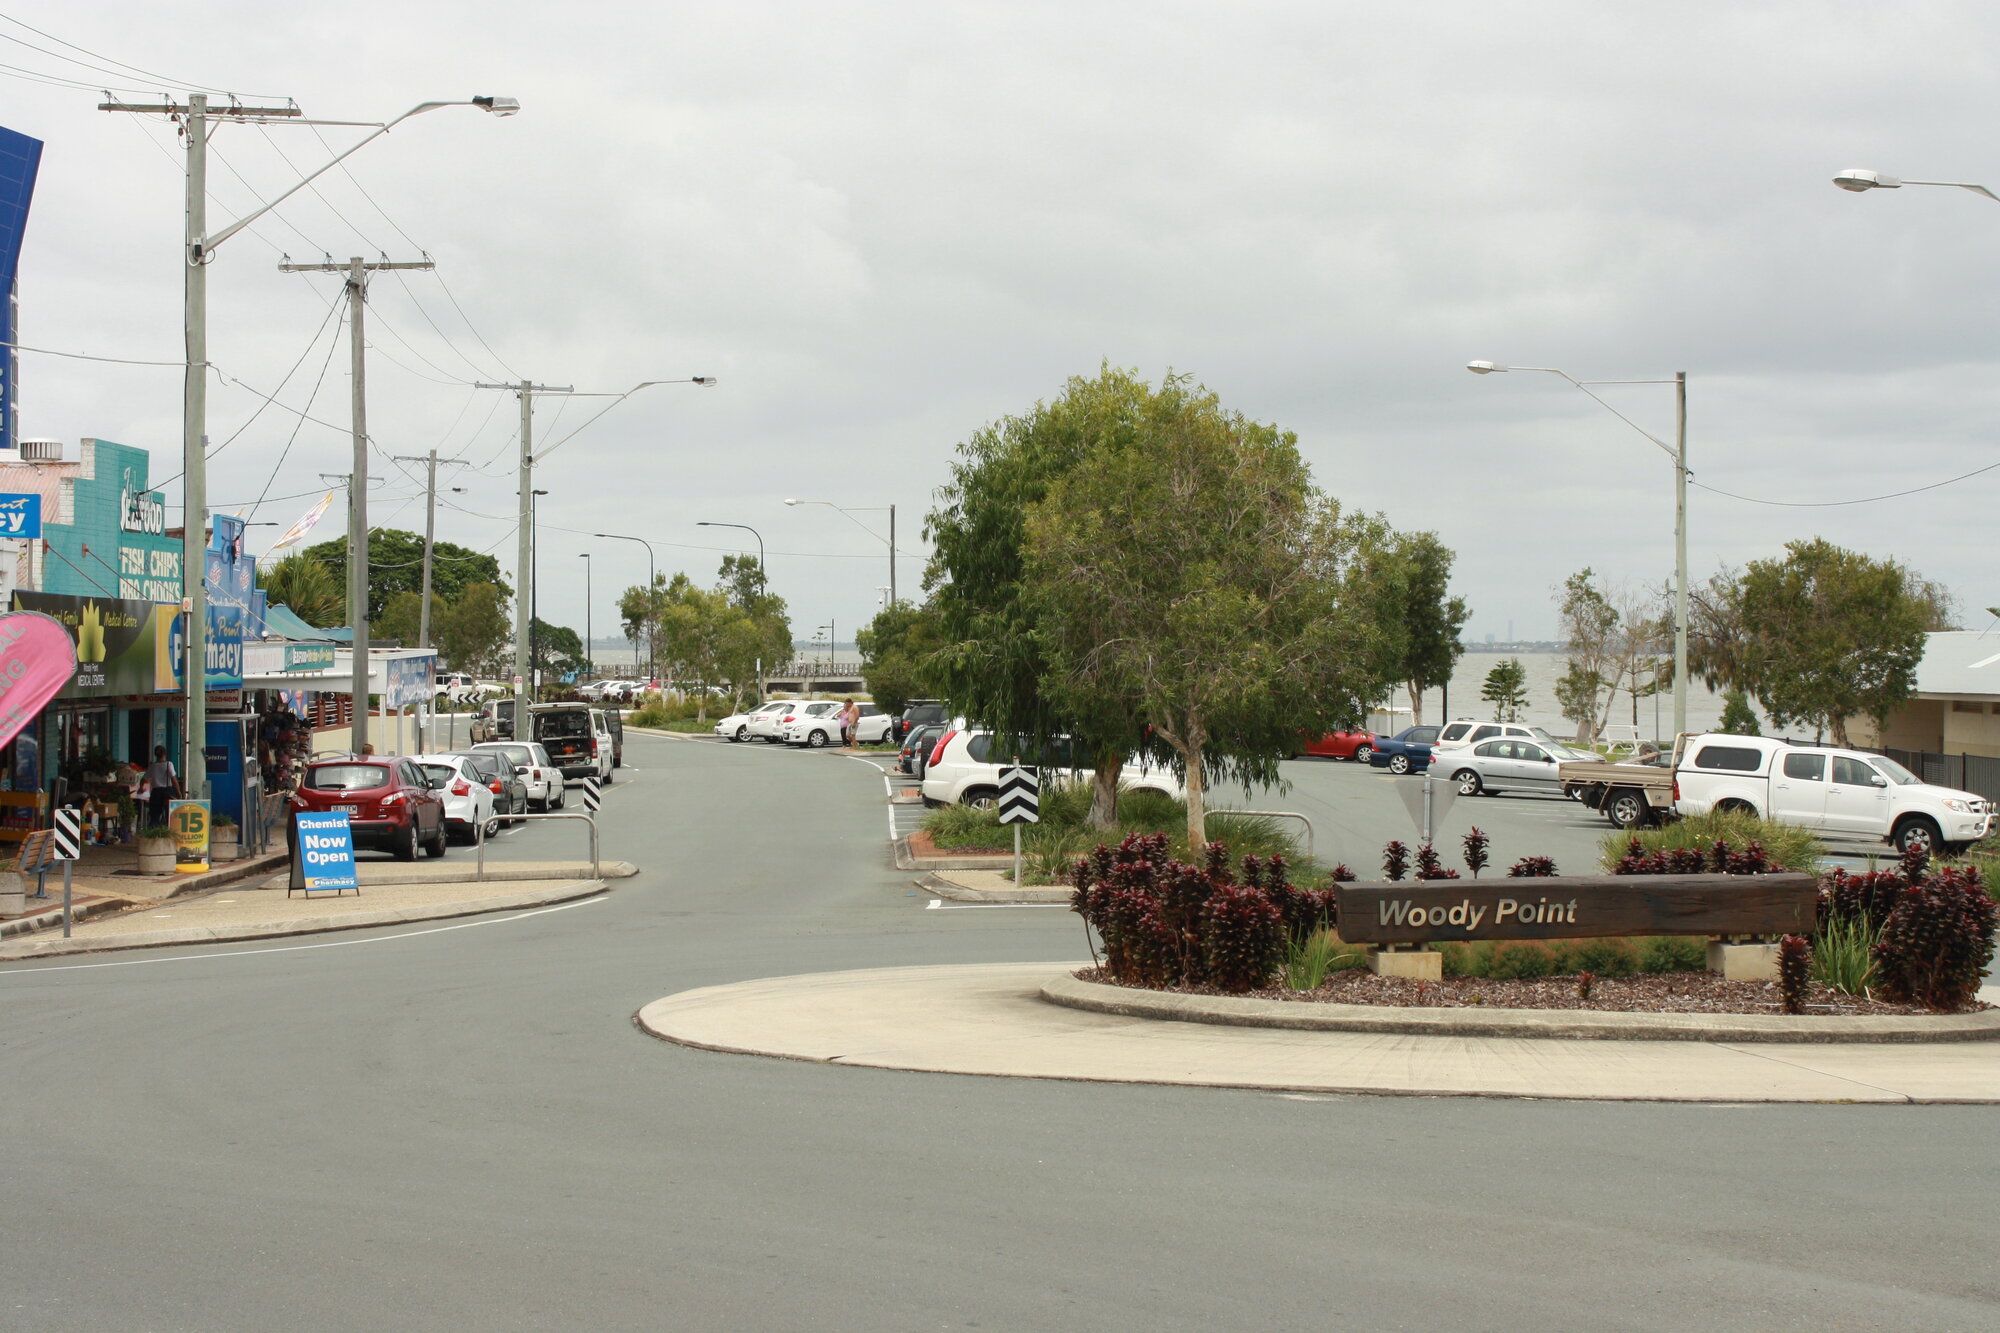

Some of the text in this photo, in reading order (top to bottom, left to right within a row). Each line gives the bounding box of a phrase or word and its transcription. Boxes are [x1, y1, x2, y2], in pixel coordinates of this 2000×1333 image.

[104, 611, 122, 627] Medical
[123, 613, 138, 628] Centre
[217, 616, 242, 637] Point
[178, 812, 204, 833] 15
[299, 818, 349, 829] Chemist
[305, 835, 347, 849] Now
[306, 851, 349, 866] Open
[1379, 897, 1578, 931] Woody Point
